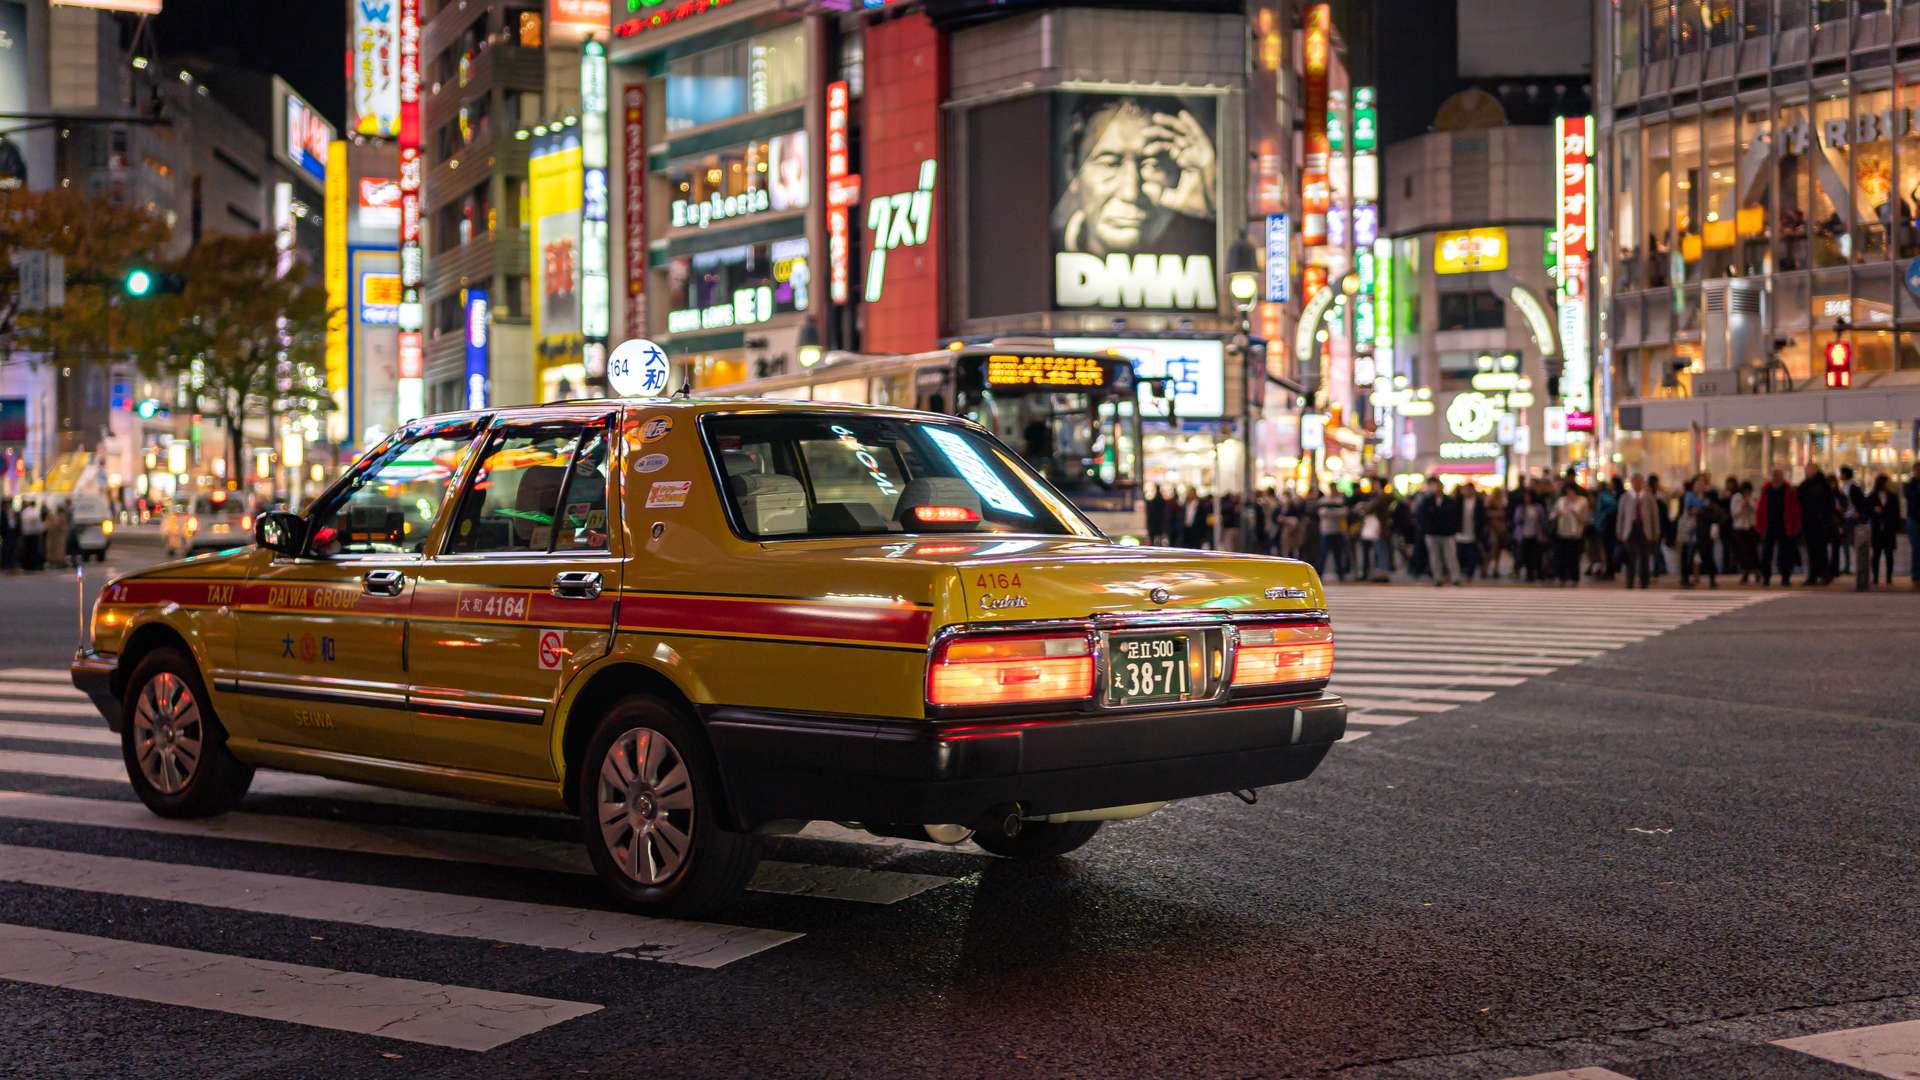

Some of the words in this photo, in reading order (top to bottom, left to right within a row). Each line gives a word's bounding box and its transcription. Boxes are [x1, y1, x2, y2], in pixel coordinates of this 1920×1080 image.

[1056, 251, 1218, 309] DMM
[607, 358, 629, 378] 164
[642, 345, 666, 391] 大和
[976, 572, 1022, 589] 4164
[207, 584, 234, 603] TAXI
[268, 586, 308, 606] DAIWA
[313, 587, 361, 609] GROUP
[484, 595, 525, 618] 4164
[1114, 672, 1124, 689] え
[1126, 659, 1186, 696] 38-71
[295, 710, 335, 729] SEIWA
